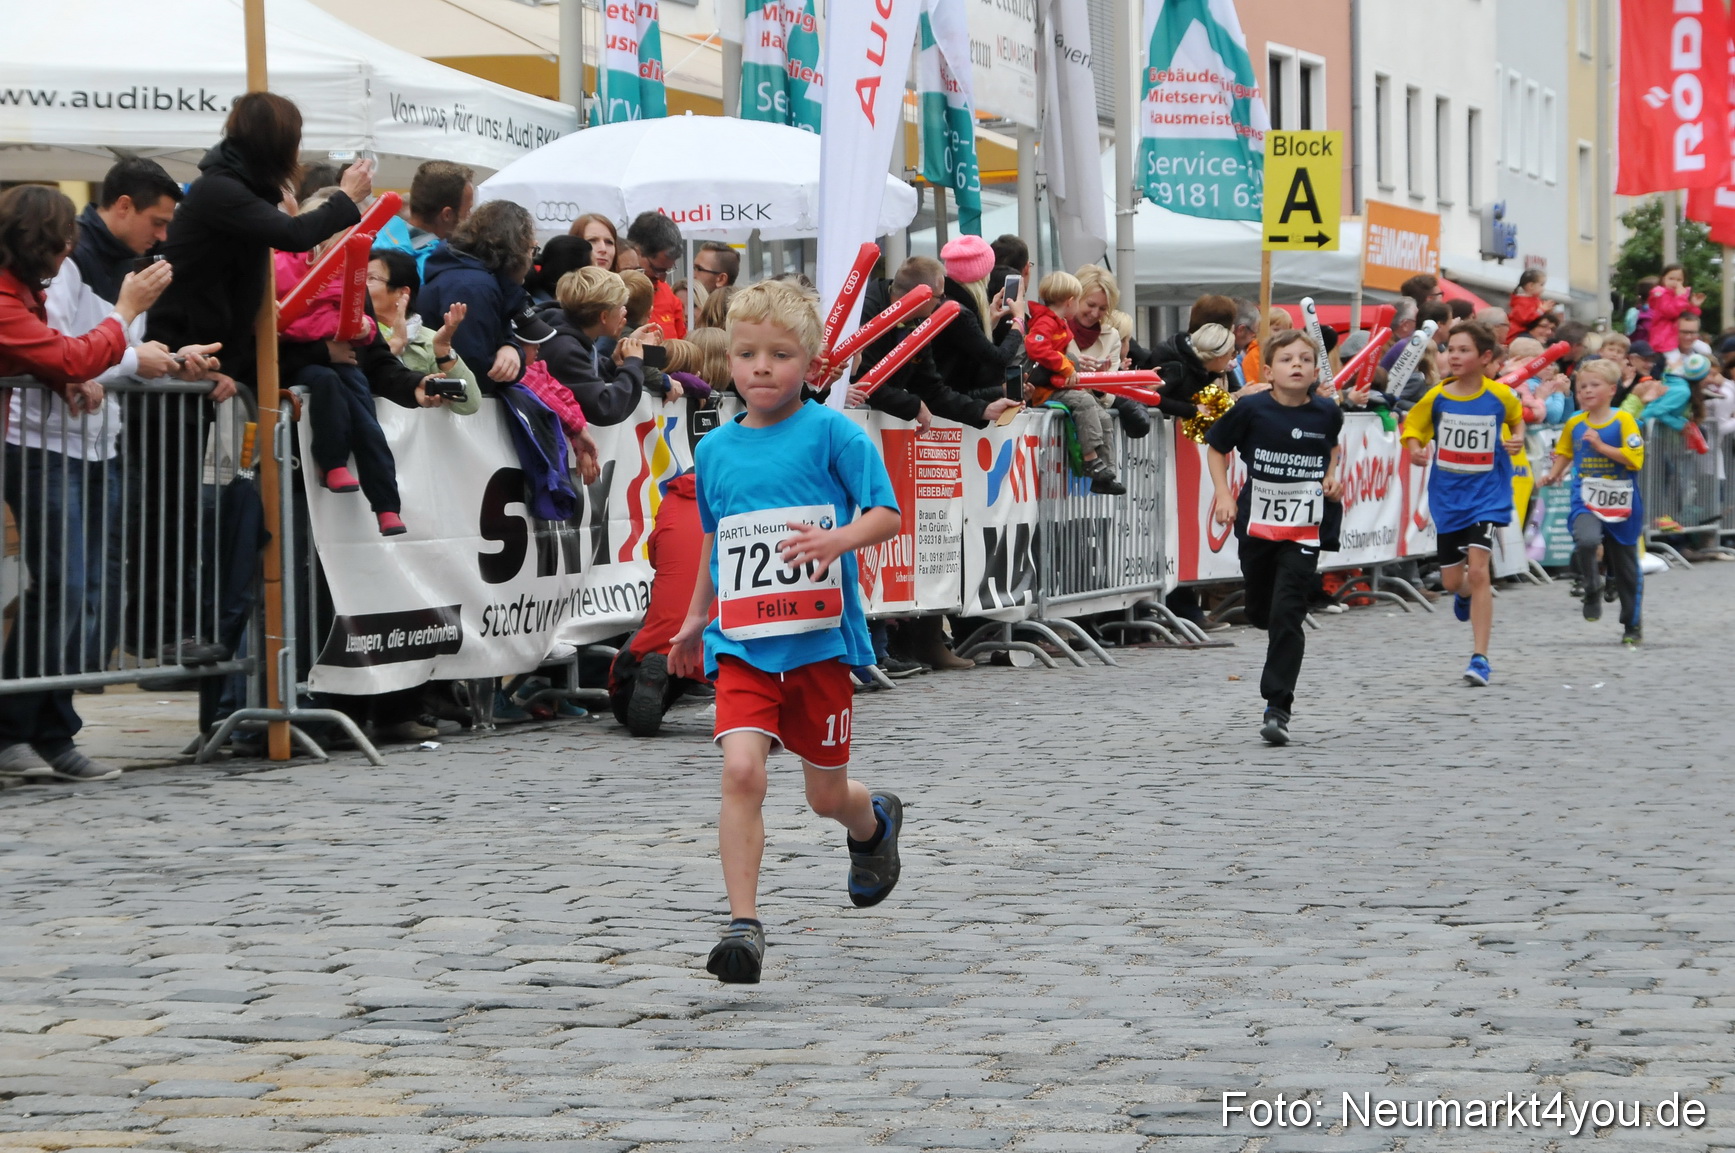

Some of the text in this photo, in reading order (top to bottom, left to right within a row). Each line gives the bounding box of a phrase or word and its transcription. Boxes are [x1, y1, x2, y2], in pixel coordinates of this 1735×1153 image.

[969, 39, 991, 69] eum
[390, 92, 419, 122] Von
[422, 104, 448, 133] uns,
[453, 103, 473, 132] für
[476, 114, 503, 141] uns:
[505, 117, 534, 149] Audi
[1273, 135, 1333, 157] Block
[1278, 167, 1323, 224] A
[720, 203, 773, 222] BKK
[820, 301, 845, 346] udi BKK
[832, 320, 874, 356] Audi BKK
[869, 340, 907, 377] Audi BKK
[1443, 426, 1490, 449] 7061
[1253, 461, 1262, 470] im
[1264, 464, 1284, 476] Haus
[1254, 448, 1323, 468] GRUNDSCHULE
[1254, 485, 1313, 496] PARTL Neumarkt
[1588, 487, 1629, 507] 7068
[919, 510, 936, 520] Braun
[1259, 497, 1315, 523] 7571
[720, 527, 752, 542] PARTL
[919, 523, 928, 532] Am
[919, 552, 929, 562] Tel.
[919, 564, 929, 574] Fax
[757, 598, 798, 619] Felix
[388, 628, 405, 649] die
[408, 622, 458, 646] verbinden
[821, 708, 850, 747] 10
